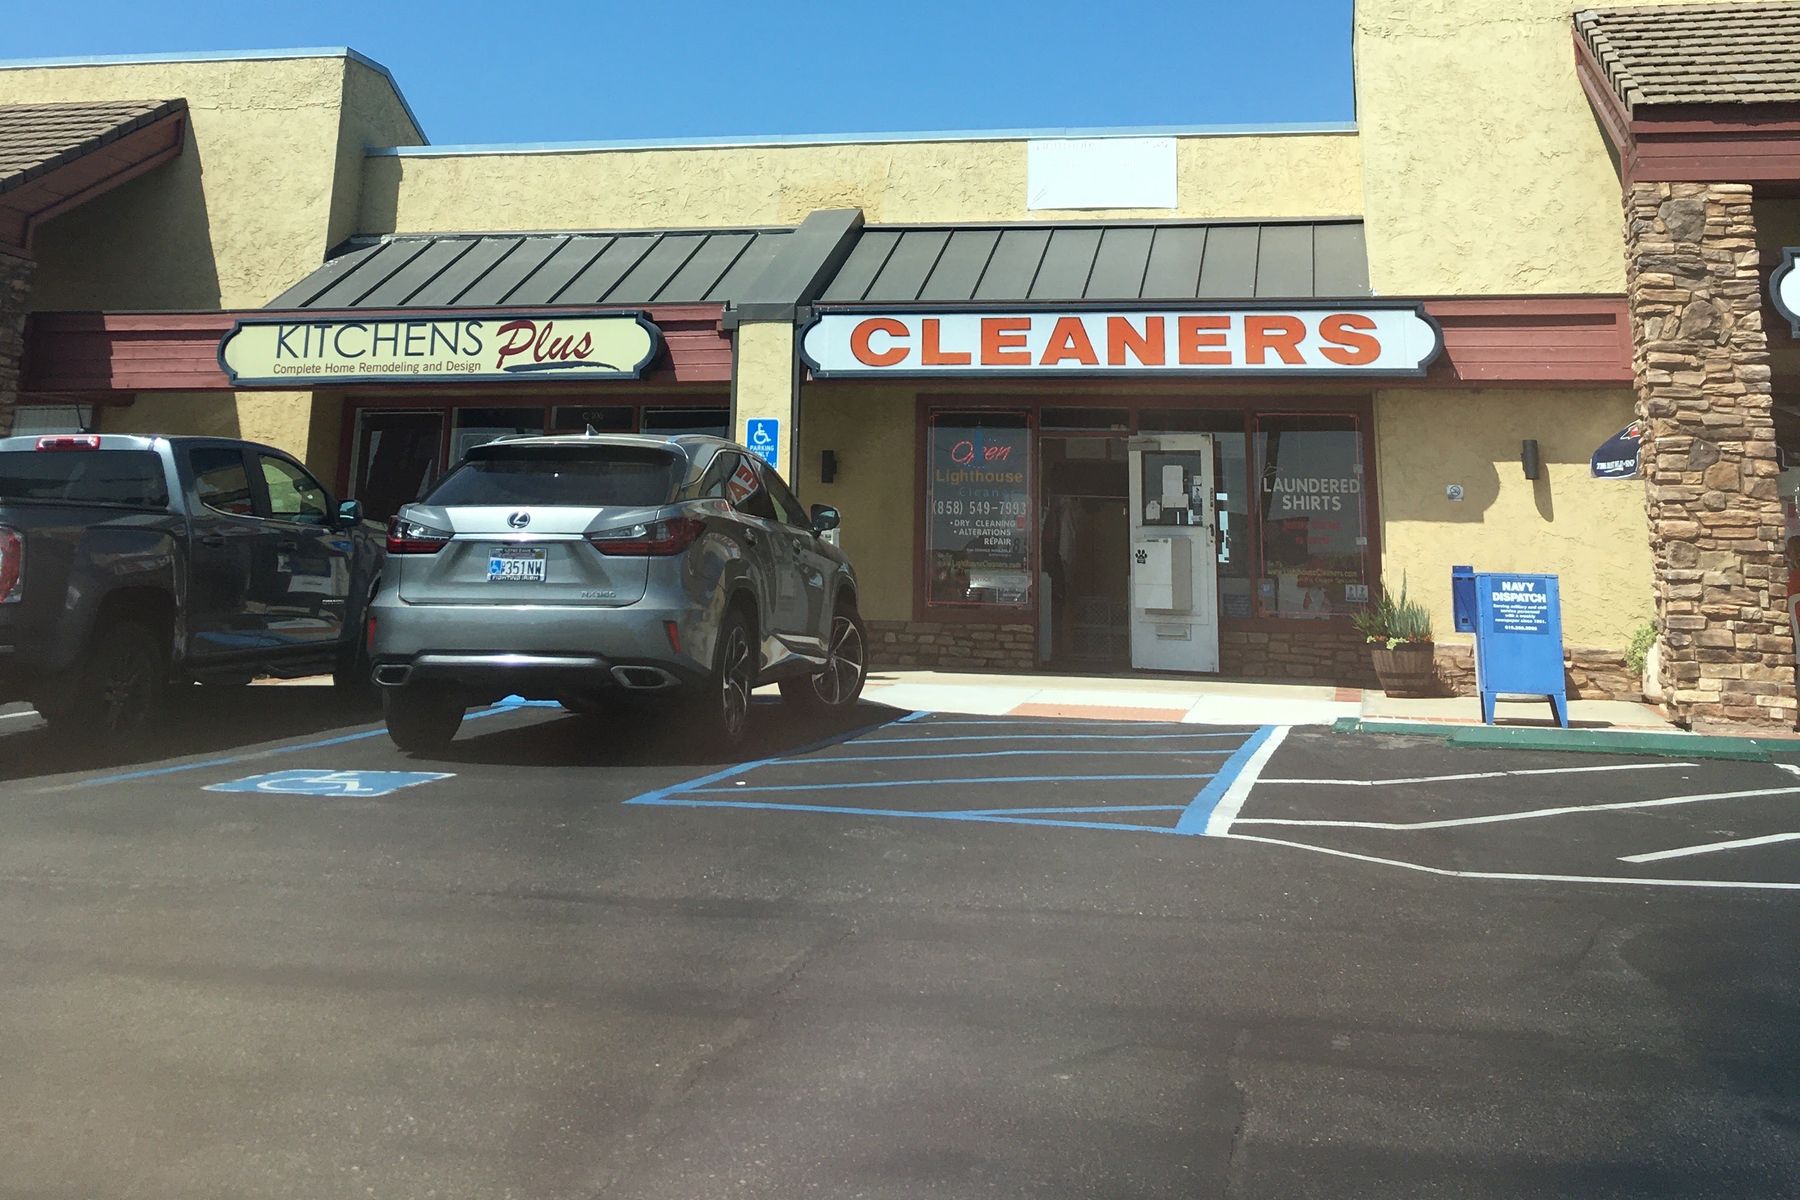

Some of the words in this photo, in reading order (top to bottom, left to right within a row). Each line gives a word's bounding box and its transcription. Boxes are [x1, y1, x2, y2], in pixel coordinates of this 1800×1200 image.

[275, 319, 484, 359] KITCHENS
[495, 318, 595, 369] Plus
[849, 313, 1382, 367] CLEANERS
[273, 363, 322, 375] Complete
[325, 362, 355, 374] Home
[358, 361, 419, 375] Remodeling
[423, 361, 442, 372] and
[446, 360, 481, 373] Design
[951, 440, 1012, 464] Oen
[936, 469, 1024, 485] Lighthouse
[1263, 477, 1360, 494] LAUNDERED
[933, 500, 963, 515] (858)
[969, 500, 1027, 515] 549-7993
[1282, 495, 1342, 511] SHIRTS
[954, 519, 970, 527] DRY
[975, 519, 1016, 528] CLEANING
[958, 528, 1012, 536] ALTERATIONS
[984, 537, 1012, 545] REPAIR
[1502, 581, 1535, 592] NAVY
[1492, 592, 1547, 603] DISPATCH
